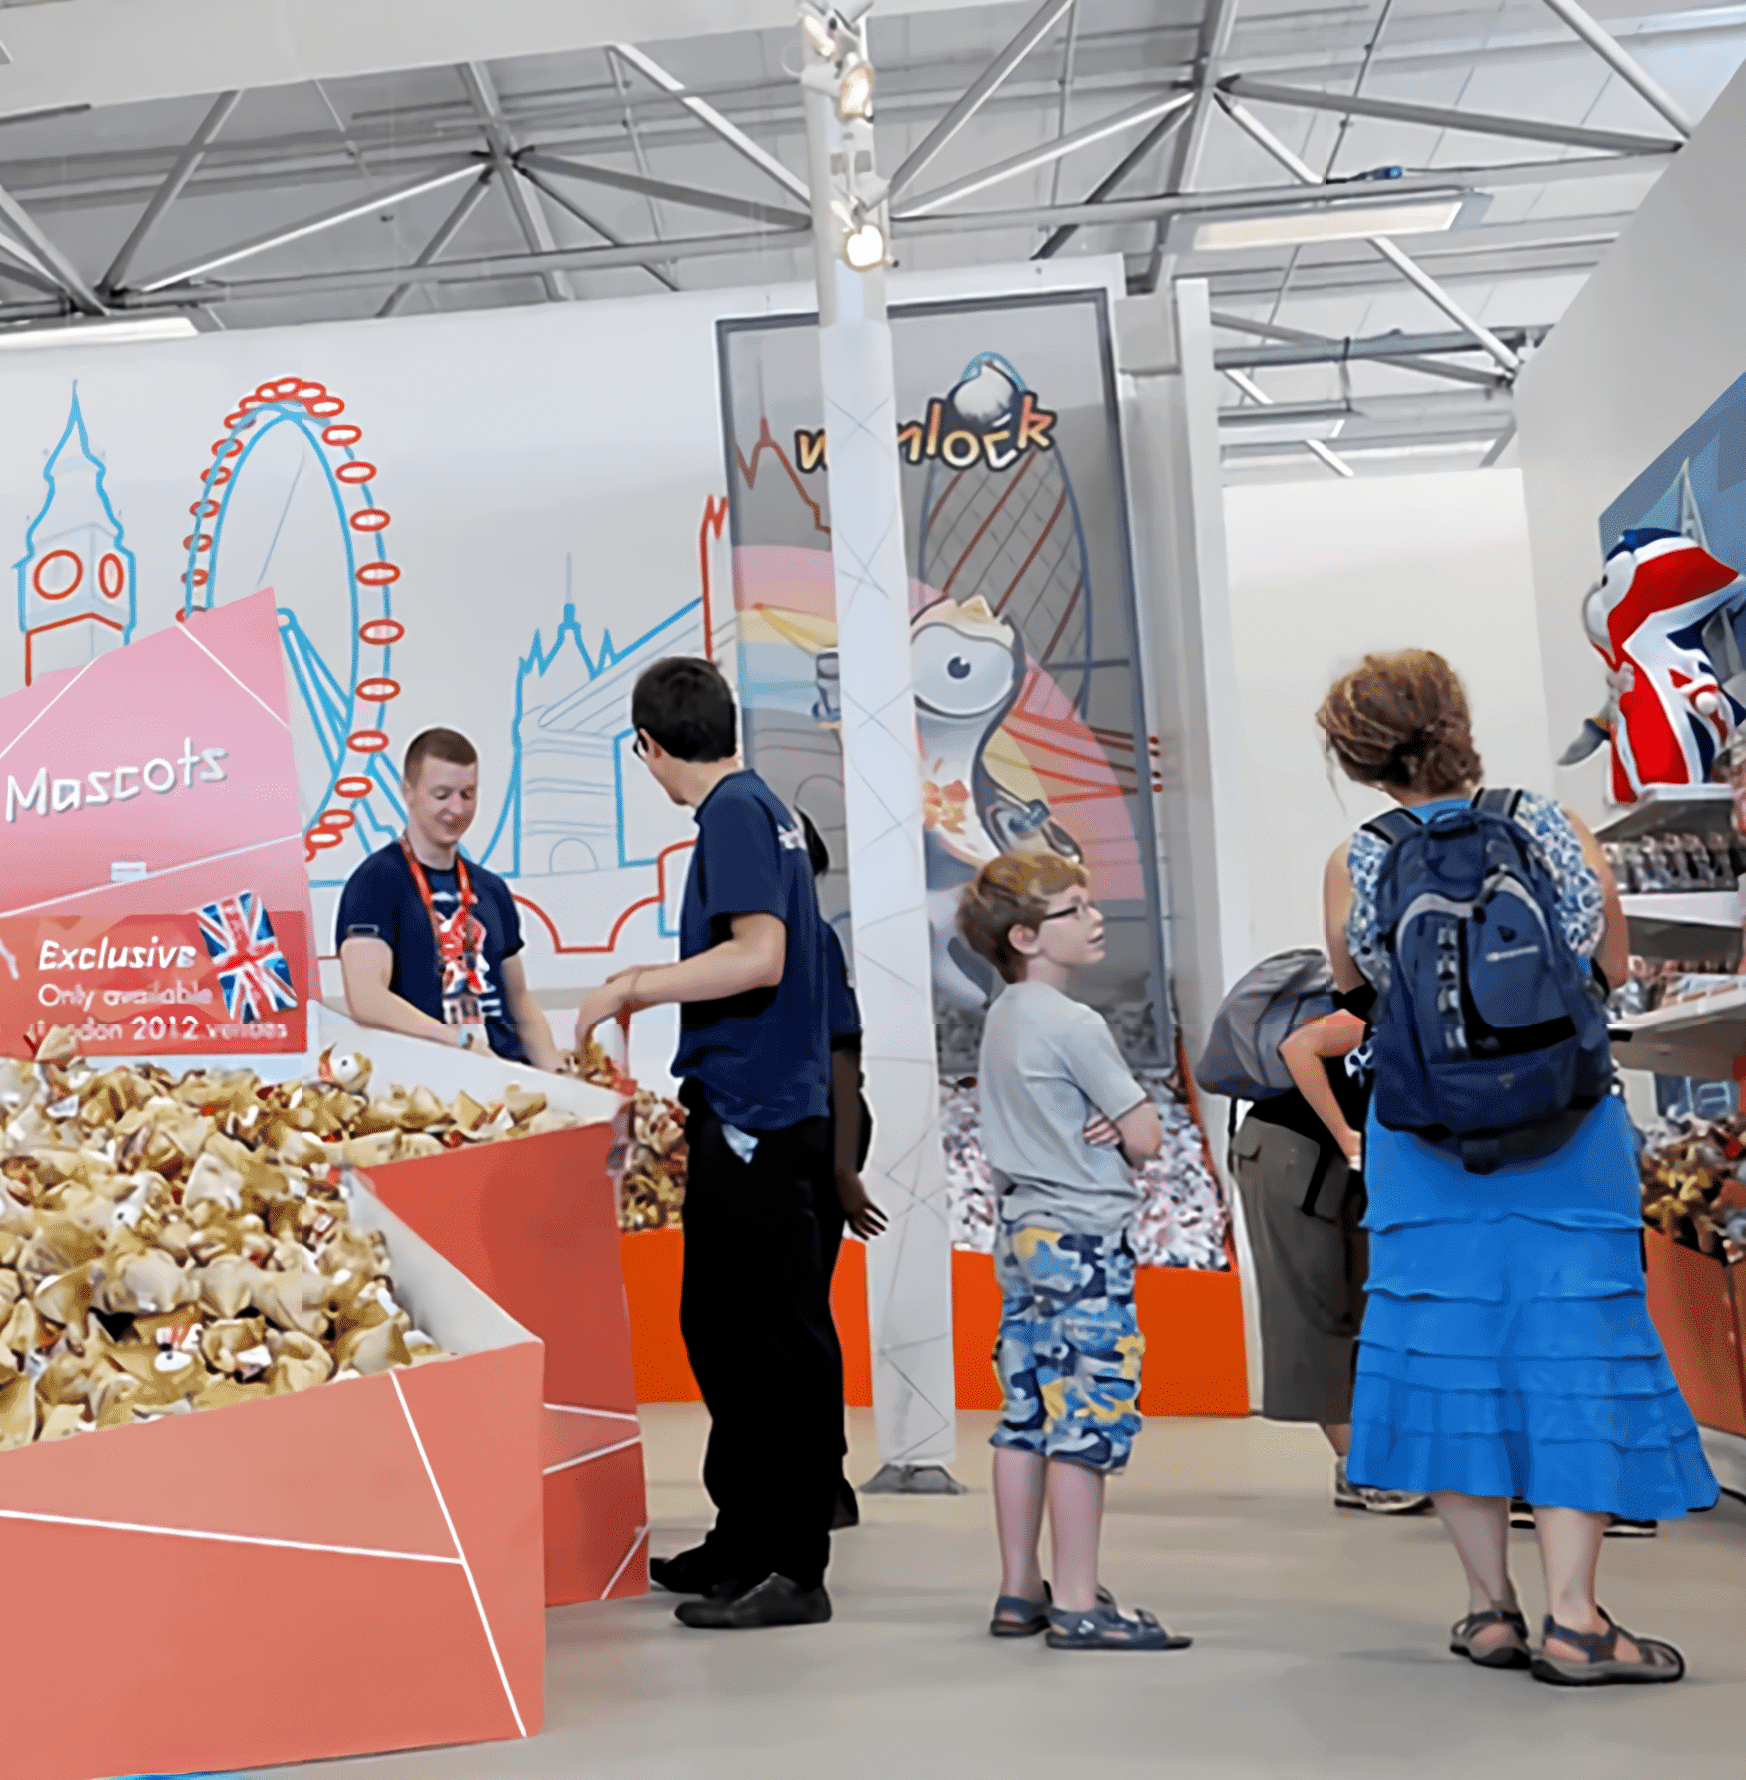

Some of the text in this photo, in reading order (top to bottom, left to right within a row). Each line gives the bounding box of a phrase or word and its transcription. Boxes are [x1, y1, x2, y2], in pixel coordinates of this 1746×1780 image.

[795, 389, 1057, 473] wnlock
[5, 736, 228, 823] Mascots
[38, 935, 198, 971] Exclusive
[37, 982, 96, 1013] Only
[130, 1015, 200, 1041] 2012
